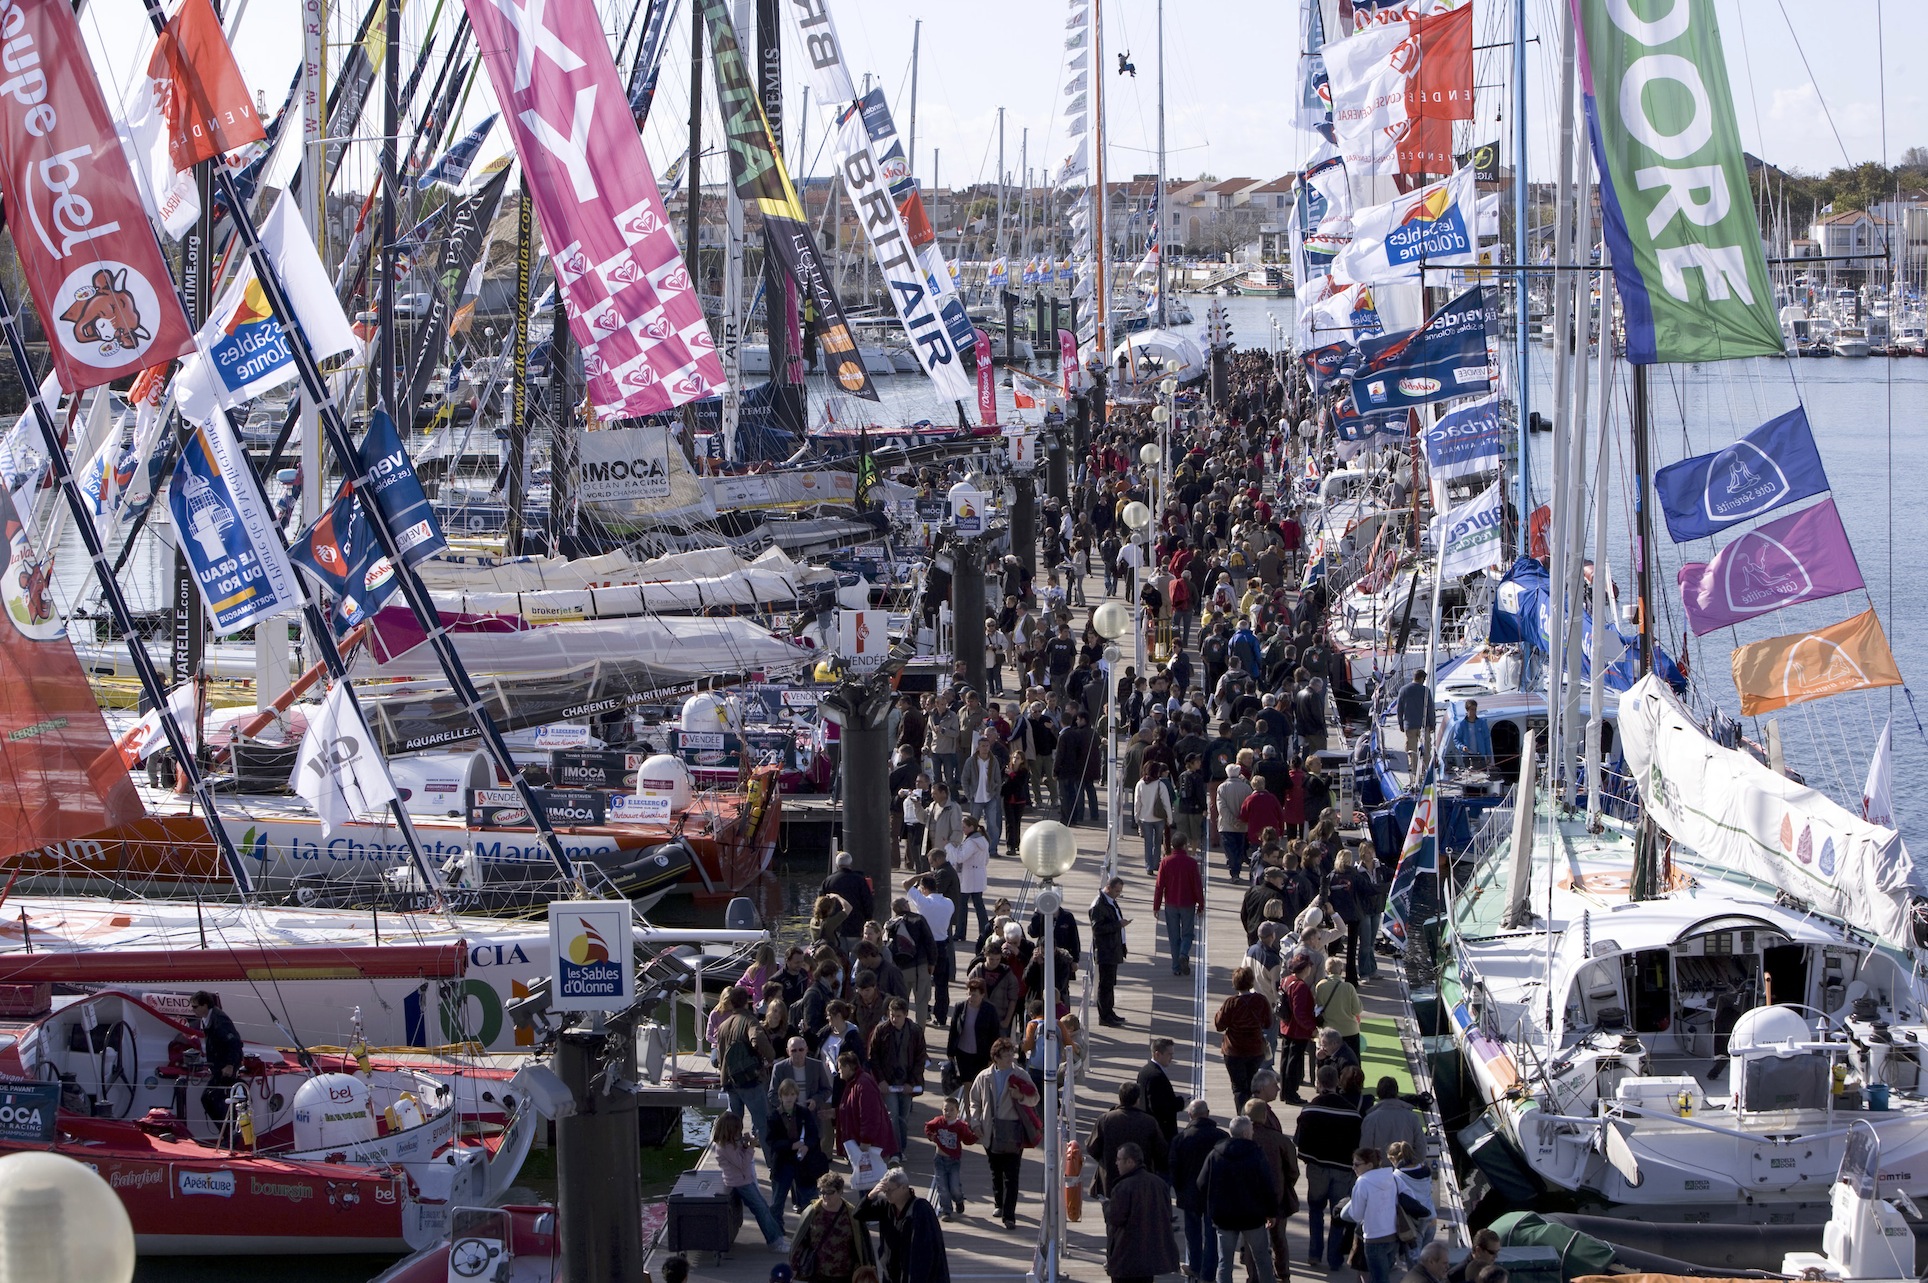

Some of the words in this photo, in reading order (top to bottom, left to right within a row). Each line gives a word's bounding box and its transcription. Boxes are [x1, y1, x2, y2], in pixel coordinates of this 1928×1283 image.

[41, 144, 120, 260] bel
[583, 459, 664, 482] IMOCA
[584, 481, 619, 490] OCEAN
[531, 605, 572, 616] brokerjet
[405, 727, 482, 749] AQUARELLE.co
[689, 732, 721, 743] VENDÉE
[564, 767, 605, 778] IMOCA
[486, 791, 521, 801] VENDÉE
[292, 837, 319, 861] la
[467, 944, 531, 967] CIA
[567, 967, 580, 979] les
[581, 966, 619, 980] Sables
[564, 980, 615, 994] d'Olonne
[157, 995, 191, 1008] VEND
[329, 1086, 352, 1104] bel
[295, 1109, 311, 1124] kiri
[9, 1123, 42, 1132] RACING
[109, 1167, 164, 1189] Babybel
[250, 1177, 313, 1203] boursin
[375, 1182, 397, 1203] bel
